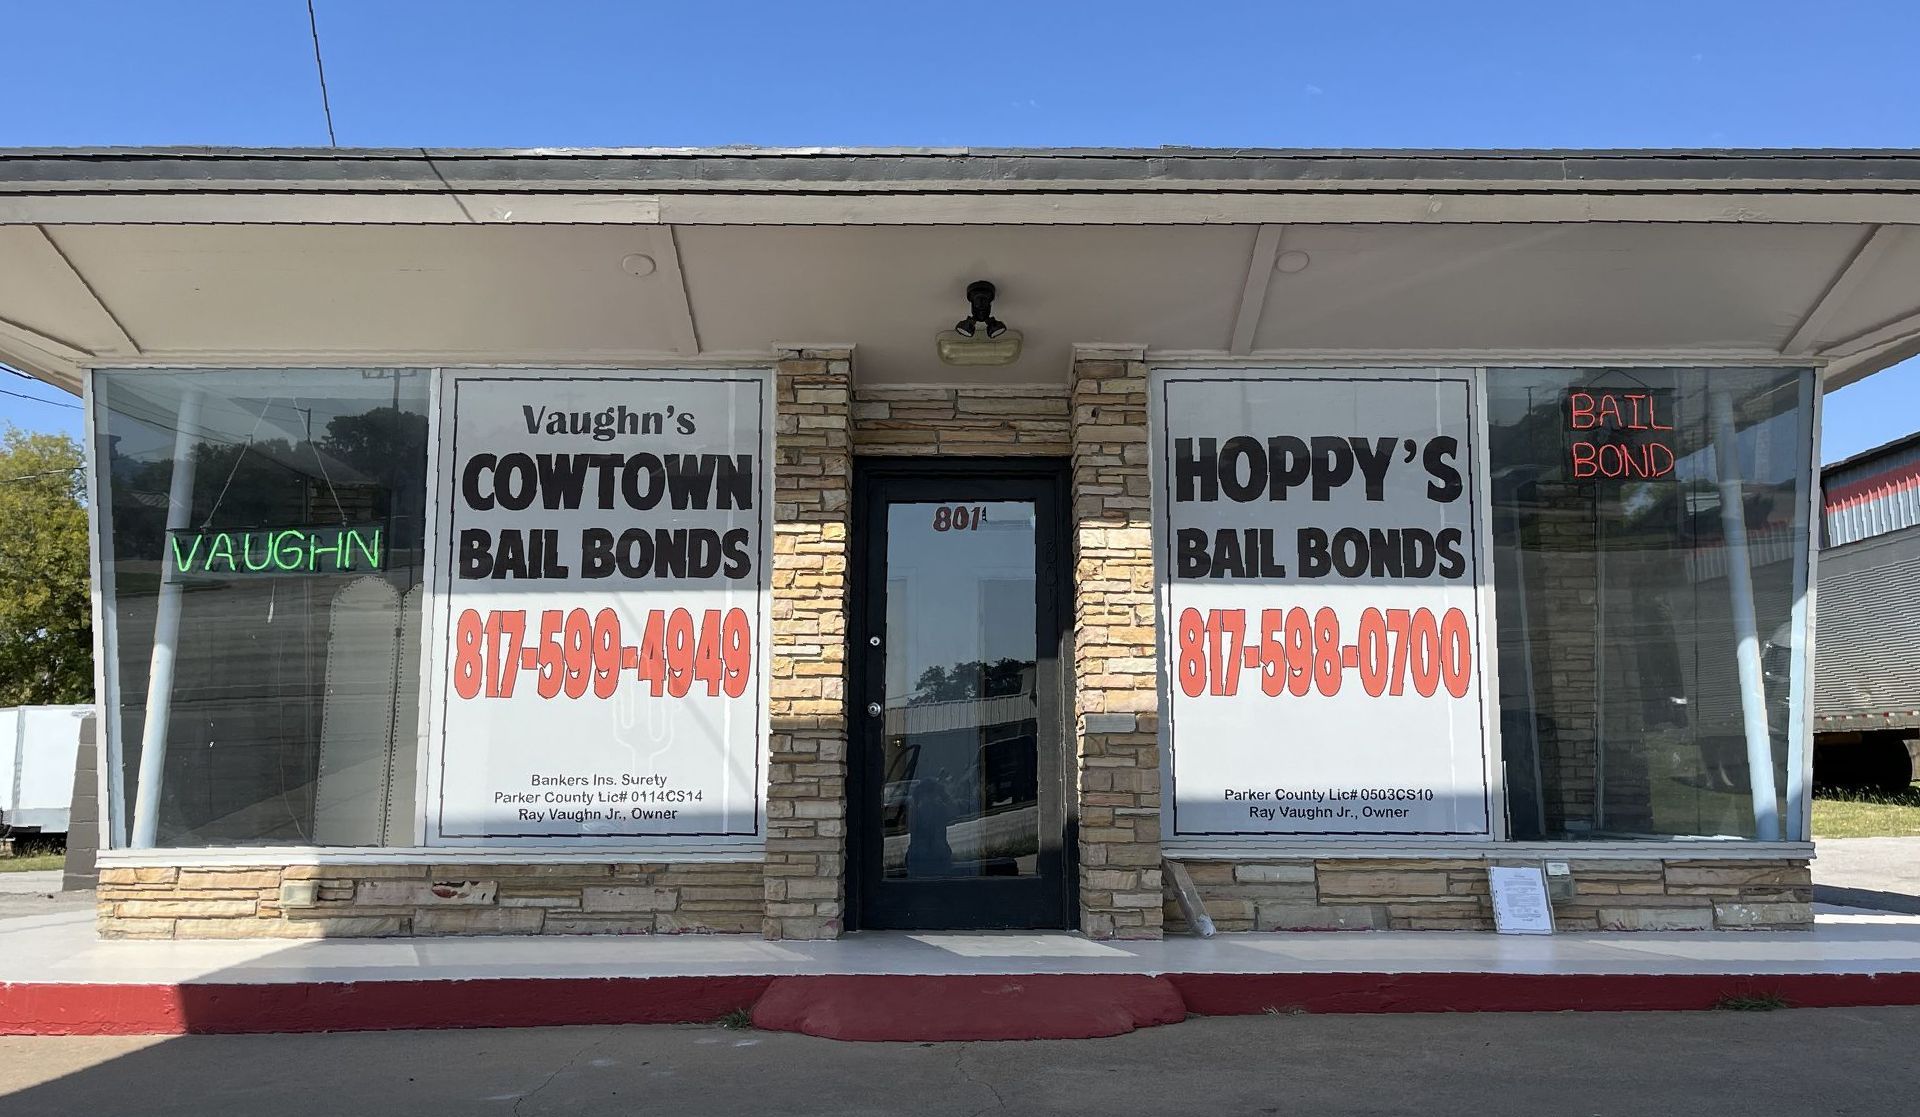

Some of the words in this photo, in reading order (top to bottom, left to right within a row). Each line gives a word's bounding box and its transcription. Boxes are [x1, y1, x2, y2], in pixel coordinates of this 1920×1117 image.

[523, 404, 696, 442] Vaughn's
[1571, 392, 1673, 431] BAIL
[1174, 435, 1463, 503] HOPPY'S
[1572, 442, 1675, 479] BOND
[462, 452, 753, 511] COWTOWN
[171, 529, 381, 573] VAUGHN
[459, 528, 569, 580] BAIL
[581, 527, 752, 580] BONDS
[1177, 527, 1286, 579] BAIL
[1297, 527, 1466, 579] BONDS
[454, 607, 751, 699] 817-599-4949
[1178, 606, 1471, 698] 817-598-0700
[495, 791, 540, 804] Parker
[545, 791, 594, 806] County
[599, 791, 627, 803] Lic#
[631, 790, 703, 803] 0114CS14
[531, 774, 589, 786] Bankers
[593, 774, 617, 786] Ins.
[621, 774, 667, 789] Surety
[1225, 789, 1270, 801] Parker
[1275, 789, 1325, 802] County
[1329, 789, 1357, 801] Lic#
[1361, 789, 1433, 801] 0503CS10
[519, 809, 545, 822] Ray
[549, 809, 601, 822] Vaughn
[605, 808, 626, 821] Jr.,
[631, 808, 678, 820] Owner
[1249, 807, 1275, 821] Ray
[1279, 806, 1332, 820] Vaughn
[1336, 806, 1358, 819] Jr.,
[1362, 806, 1409, 818] Owner
